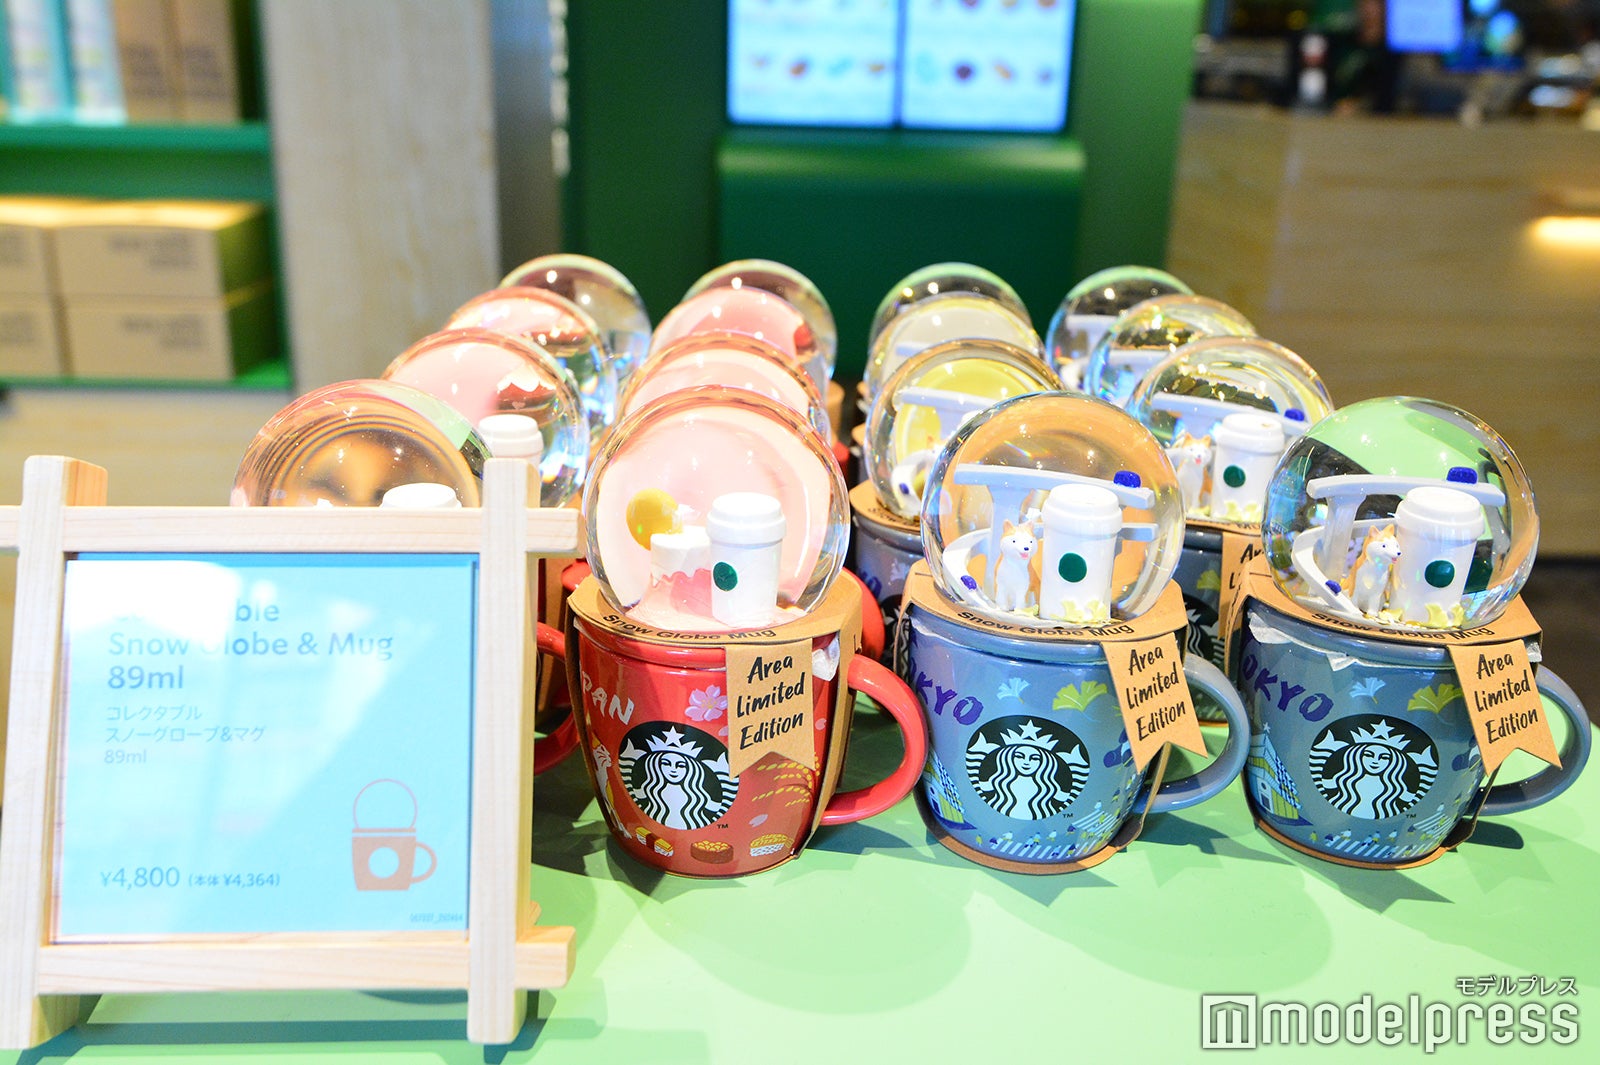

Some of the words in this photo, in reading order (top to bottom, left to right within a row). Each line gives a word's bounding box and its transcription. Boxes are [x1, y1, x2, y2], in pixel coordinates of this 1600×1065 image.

[603, 614, 654, 636] Snow
[728, 628, 777, 640] Mug
[958, 611, 1014, 631] Snow
[1089, 624, 1135, 637] Mug
[1311, 612, 1371, 632] Snow
[1450, 627, 1496, 641] Mug
[108, 631, 190, 656] Snow
[203, 631, 289, 656] lobe
[297, 631, 319, 656] &
[328, 631, 394, 662] Mug
[1128, 644, 1165, 676] Area
[107, 664, 185, 690] 89ml
[747, 655, 793, 684] Area
[1243, 640, 1334, 722] OKYO
[1476, 653, 1514, 680] Area
[736, 671, 806, 718] Limited
[911, 657, 984, 725] KYO
[1127, 662, 1180, 710] Limited
[1474, 669, 1531, 713] Limited
[106, 703, 203, 722] コレクタブル
[1137, 701, 1186, 742] Edition
[1485, 707, 1539, 745] Edition
[105, 725, 267, 744] スノーグローブ&マグ
[739, 712, 804, 750] Edition
[103, 748, 148, 764] 89ml
[100, 866, 181, 890] ¥4,800
